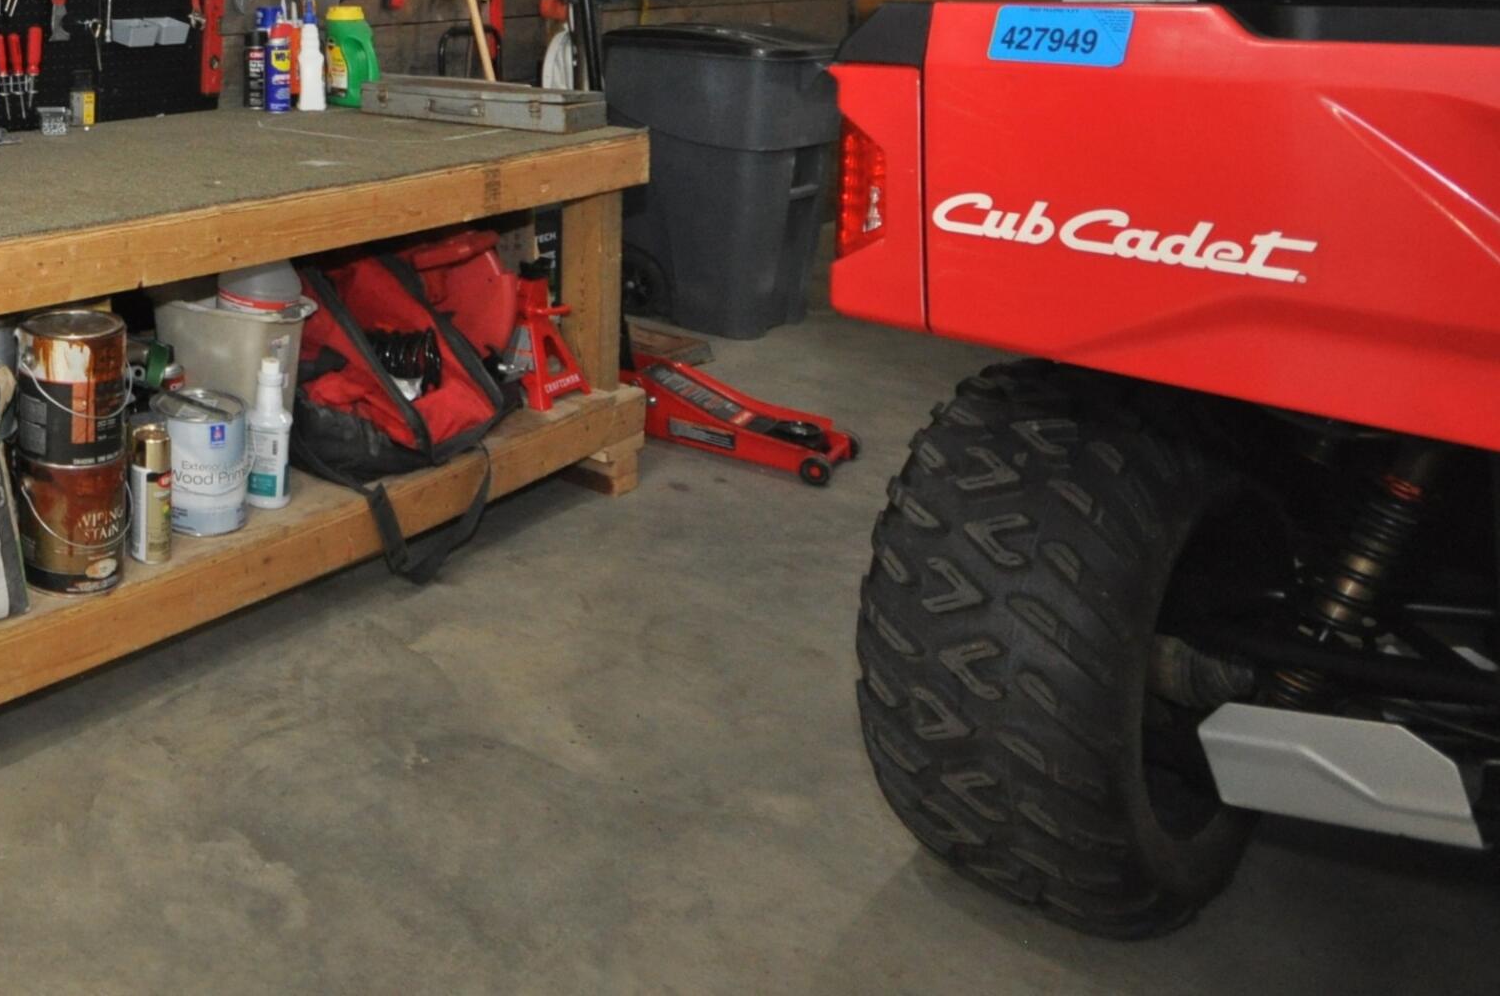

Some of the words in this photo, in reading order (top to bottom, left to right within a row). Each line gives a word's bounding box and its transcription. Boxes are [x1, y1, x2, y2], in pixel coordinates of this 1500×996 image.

[1000, 25, 1099, 55] 427949
[932, 192, 1056, 245] Cub
[1059, 208, 1318, 284] Cadet
